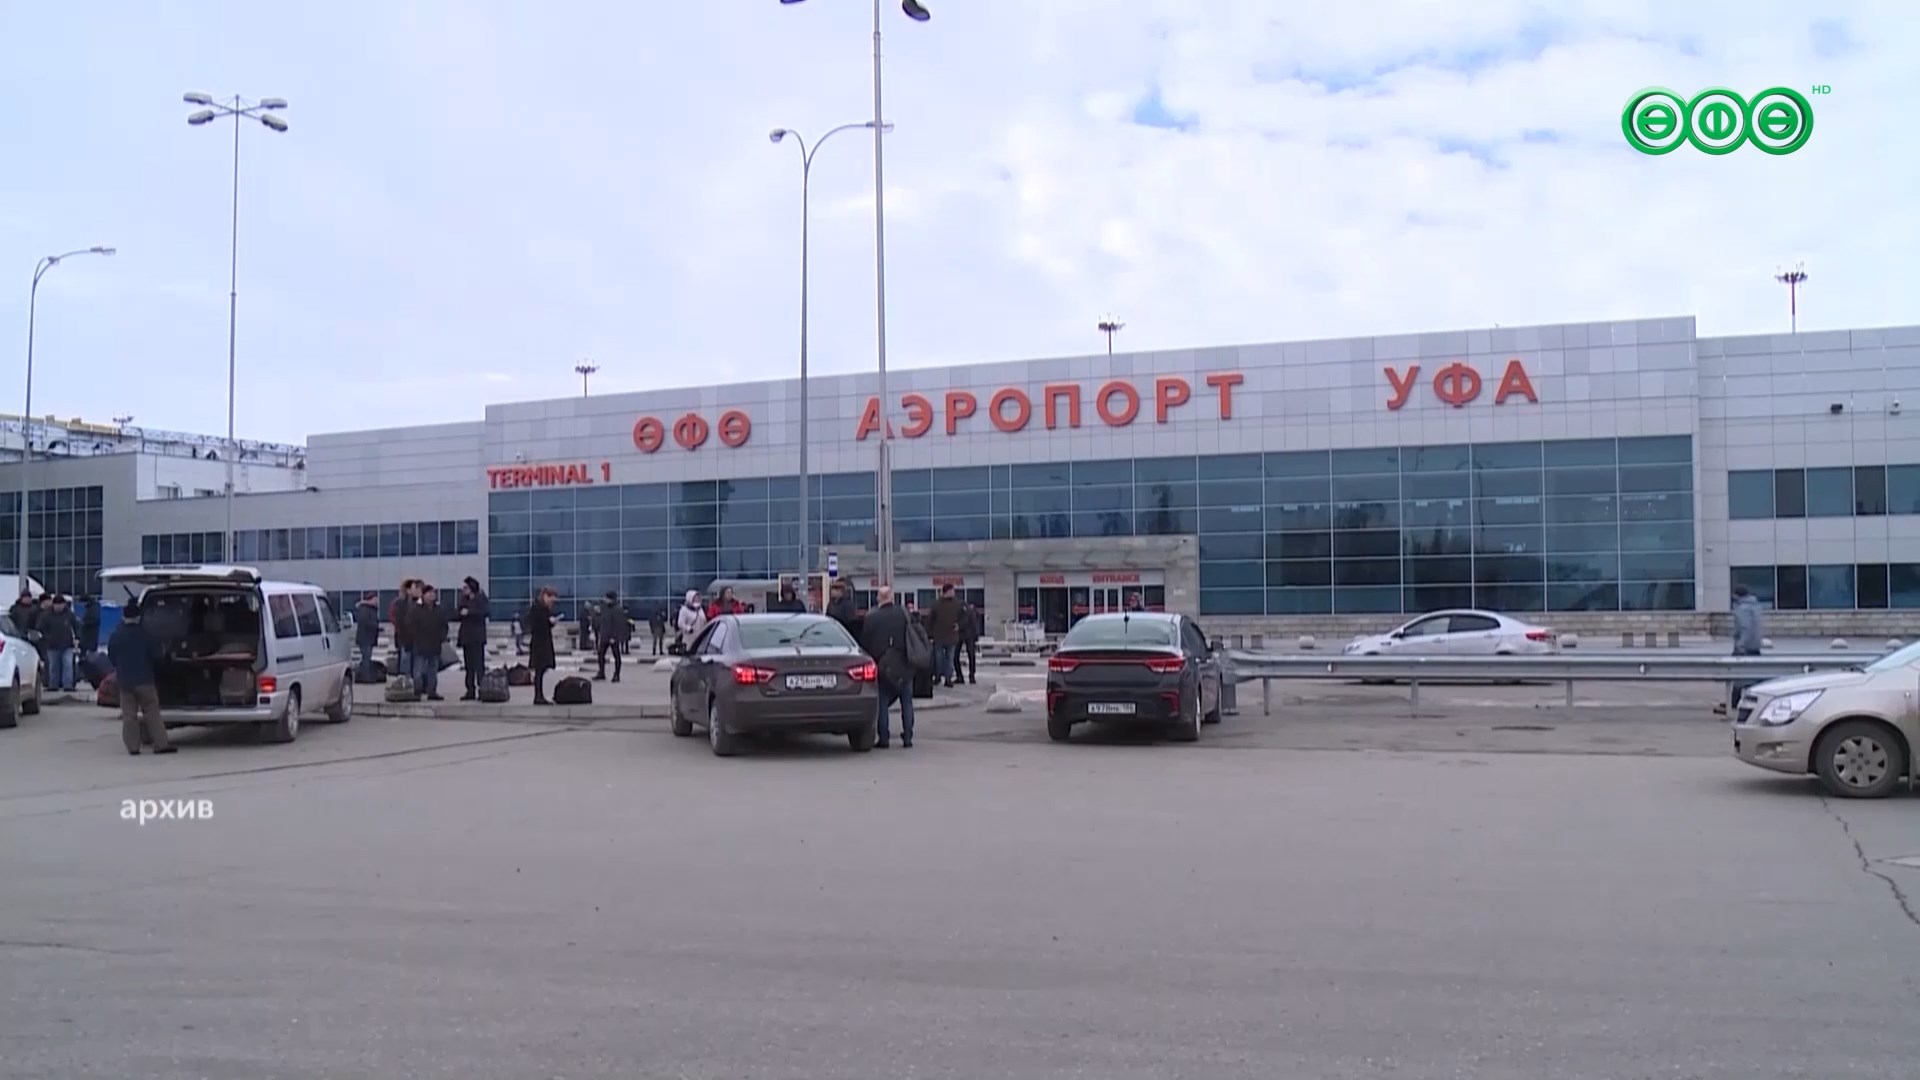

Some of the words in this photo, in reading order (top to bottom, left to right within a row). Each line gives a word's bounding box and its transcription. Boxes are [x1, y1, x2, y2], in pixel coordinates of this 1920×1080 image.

[854, 373, 1245, 441] АЭРОПОРТ
[1383, 358, 1539, 411] УФА
[487, 463, 594, 489] TERMINAL
[601, 461, 611, 484] 1
[1091, 571, 1141, 584] ENTRANCE
